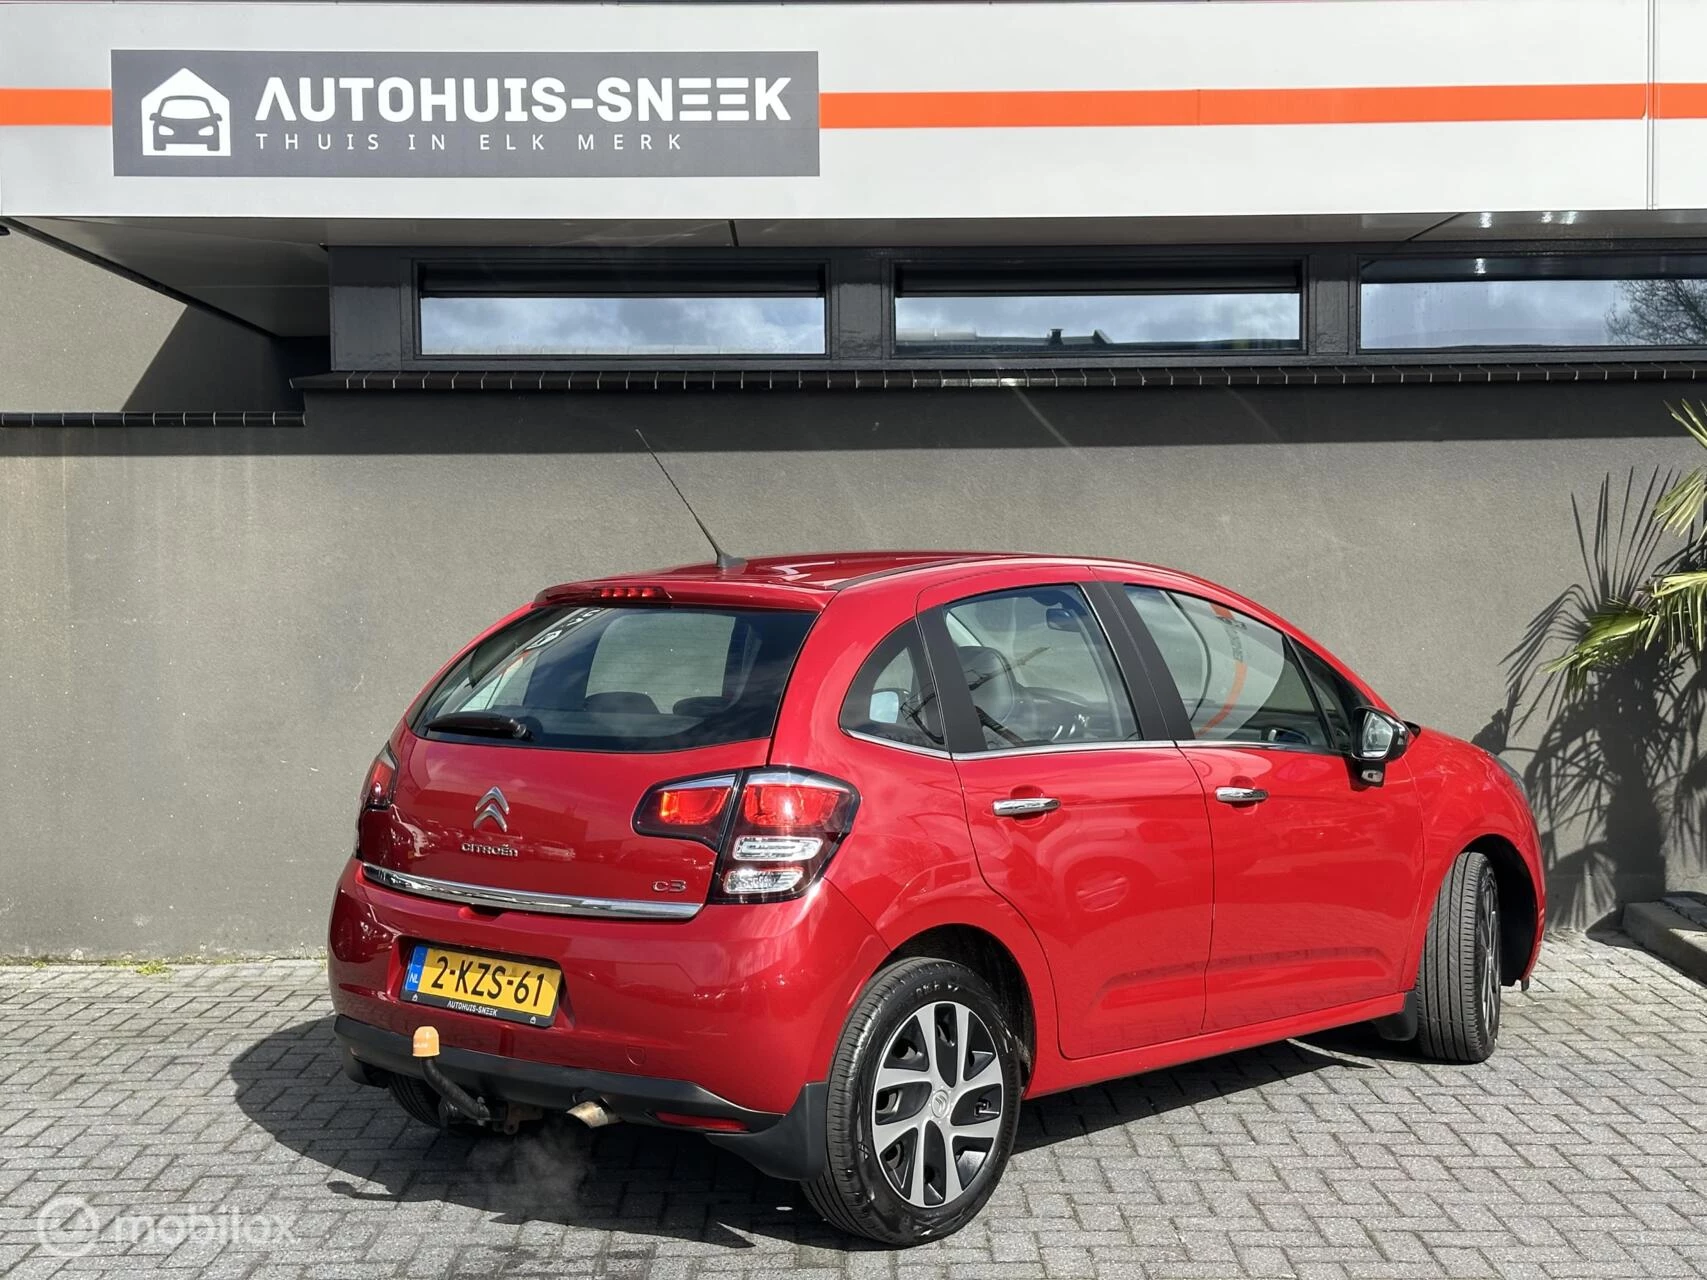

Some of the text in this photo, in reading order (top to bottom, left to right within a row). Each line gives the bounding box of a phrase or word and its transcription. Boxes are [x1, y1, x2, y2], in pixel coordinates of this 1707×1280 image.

[254, 77, 792, 122] AUTOHUIS-SNEEK
[256, 134, 682, 151] THUIS IN ELK MERK
[652, 879, 687, 893] C3
[409, 955, 545, 1008] NL 2-KZS-61
[446, 1000, 499, 1017] AUTOHUIS-SNEEK
